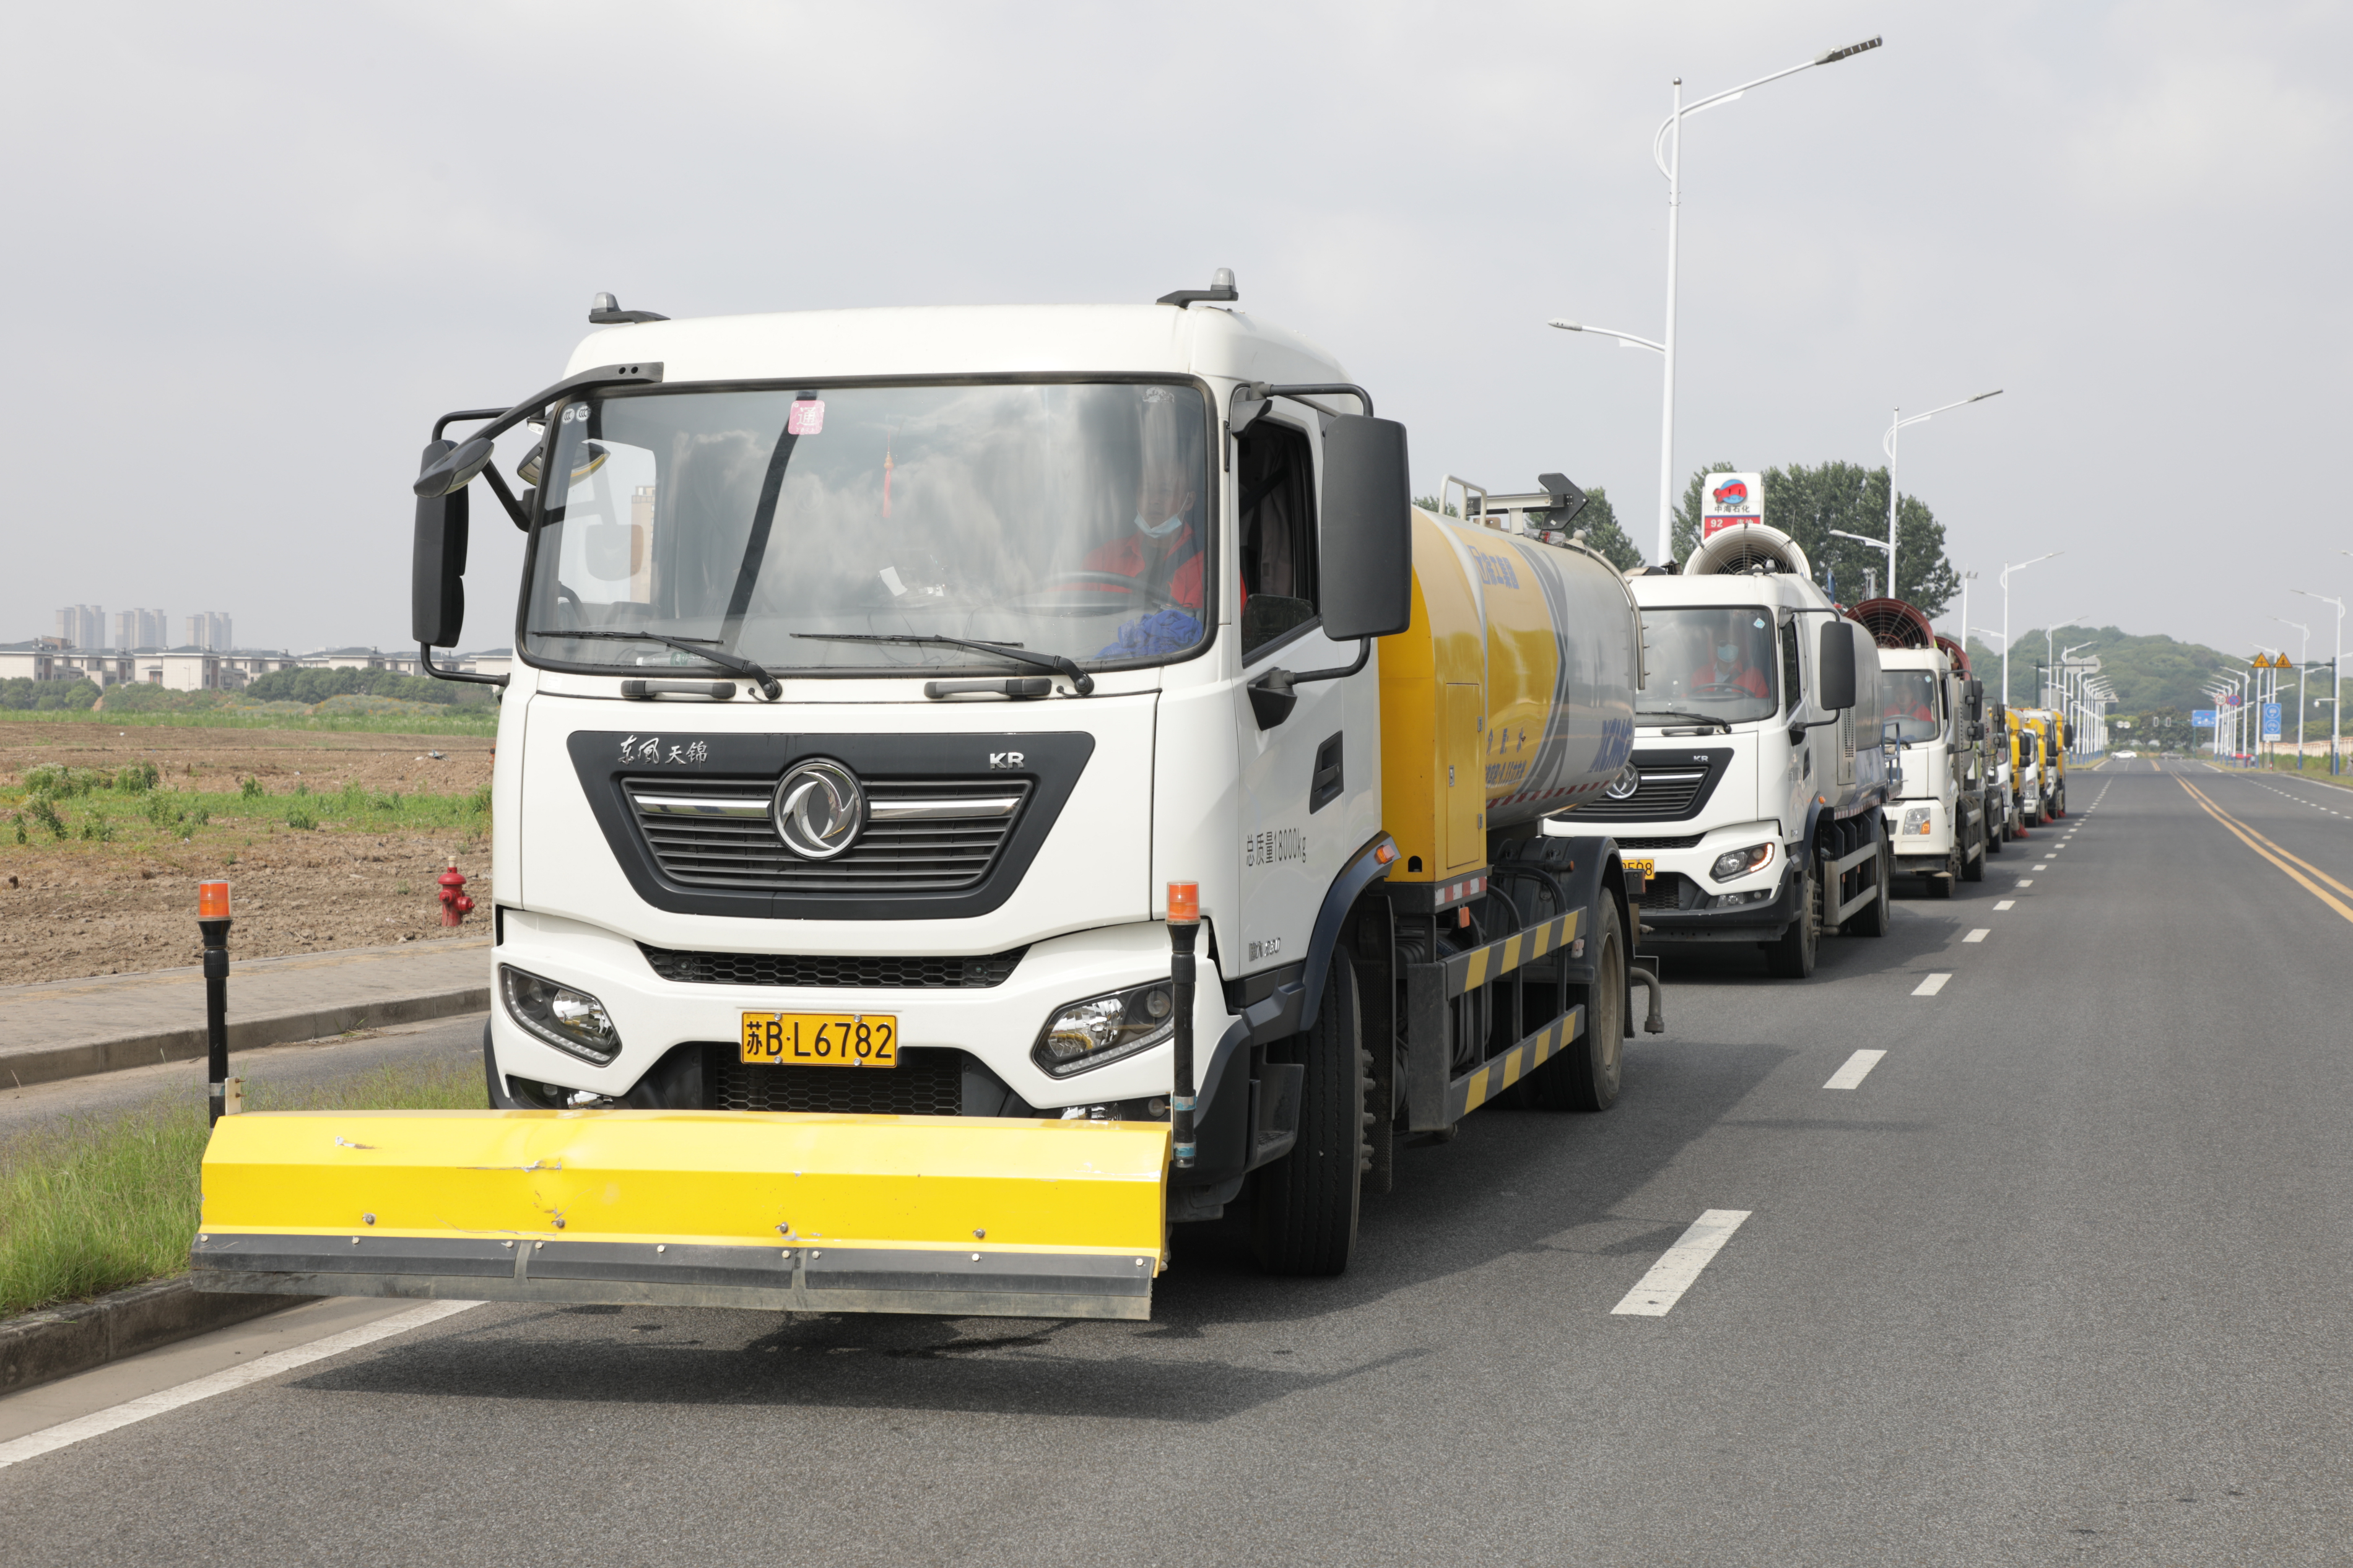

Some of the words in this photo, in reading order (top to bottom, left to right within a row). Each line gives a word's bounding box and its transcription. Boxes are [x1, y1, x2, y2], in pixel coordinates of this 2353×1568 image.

[796, 407, 816, 426] 通
[1715, 505, 1750, 513] 中海石化
[1710, 519, 1723, 527] 92
[1481, 551, 1520, 589] 徐工集团
[1587, 718, 1633, 773] XCMG
[989, 752, 1024, 769] KR
[1246, 827, 1306, 867] 总质量18000kg
[1264, 937, 1281, 957] 230
[746, 1020, 892, 1059] 苏B·L6782
